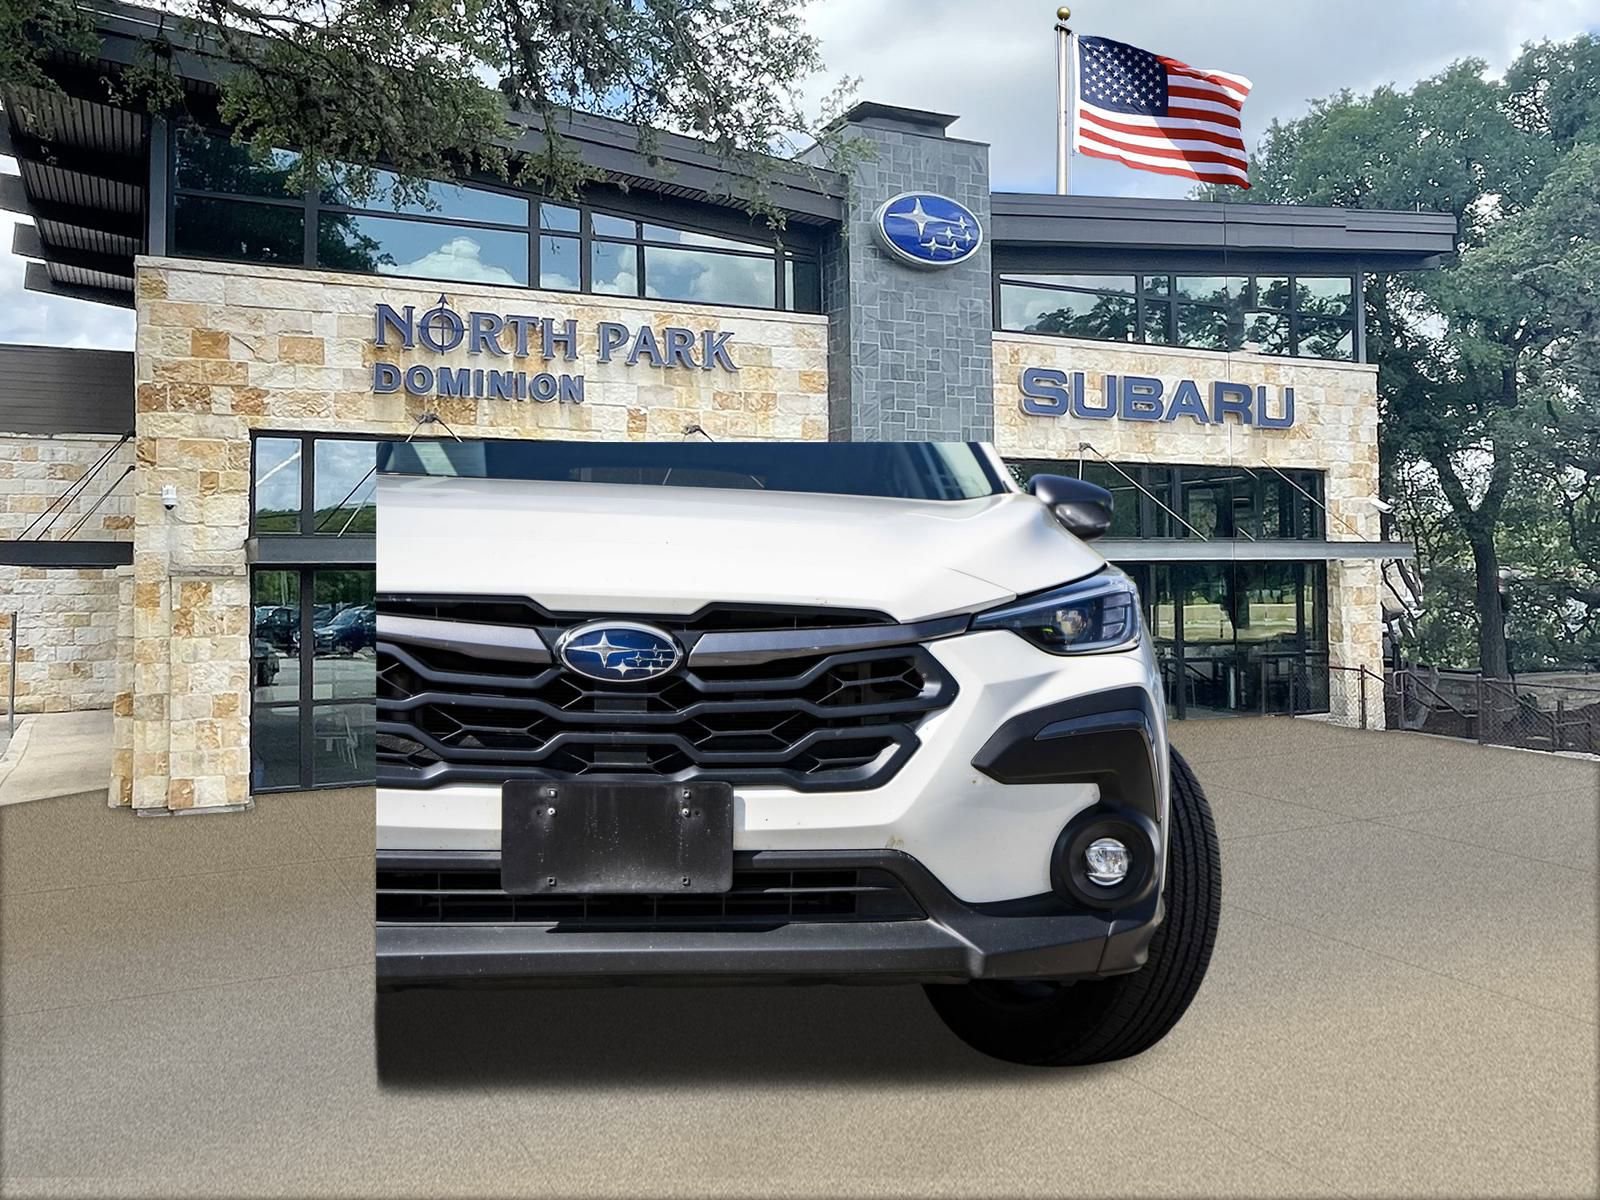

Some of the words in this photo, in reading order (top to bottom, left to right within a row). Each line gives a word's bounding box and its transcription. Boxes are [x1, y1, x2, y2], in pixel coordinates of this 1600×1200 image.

[374, 300, 580, 361] NORTH
[597, 320, 742, 373] PARK
[373, 361, 586, 404] DOMINION
[1019, 367, 1295, 429] SUBARU
